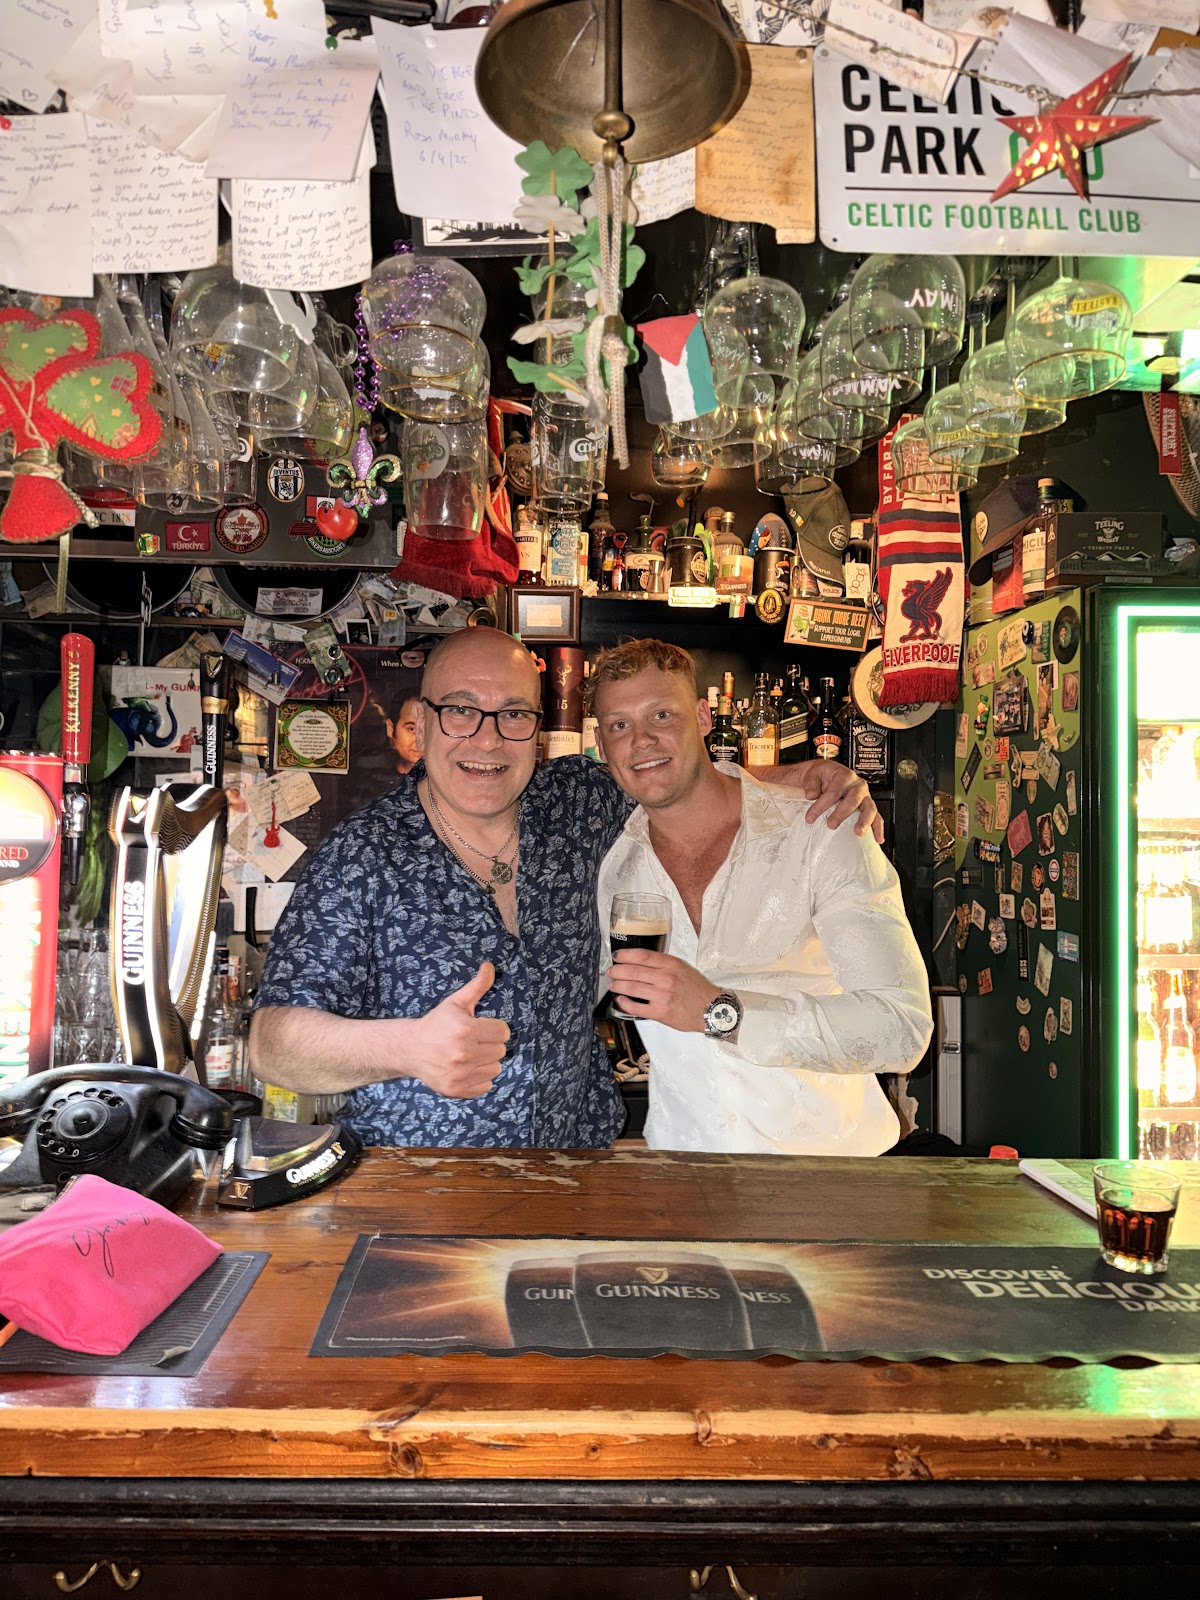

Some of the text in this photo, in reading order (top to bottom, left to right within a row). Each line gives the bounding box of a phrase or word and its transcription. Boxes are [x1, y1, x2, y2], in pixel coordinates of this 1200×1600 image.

[844, 123, 986, 176] PARK
[848, 203, 1141, 233] CELTIC FOOTBALL CLUB
[272, 469, 299, 477] JUVENTUS
[883, 450, 893, 480] FAR
[883, 485, 893, 505] BY
[1094, 519, 1125, 531] TEELING
[850, 612, 867, 628] BEER
[883, 643, 959, 669] LIVERPOOL
[65, 661, 81, 734] KILKENNY
[205, 723, 217, 775] GUINNESS
[749, 742, 774, 750] TEACHER'S
[122, 881, 146, 986] GUINNESS
[285, 1148, 337, 1184] GUINNESS
[921, 1268, 1072, 1281] DISCOVER
[596, 1283, 721, 1300] GUINNESS
